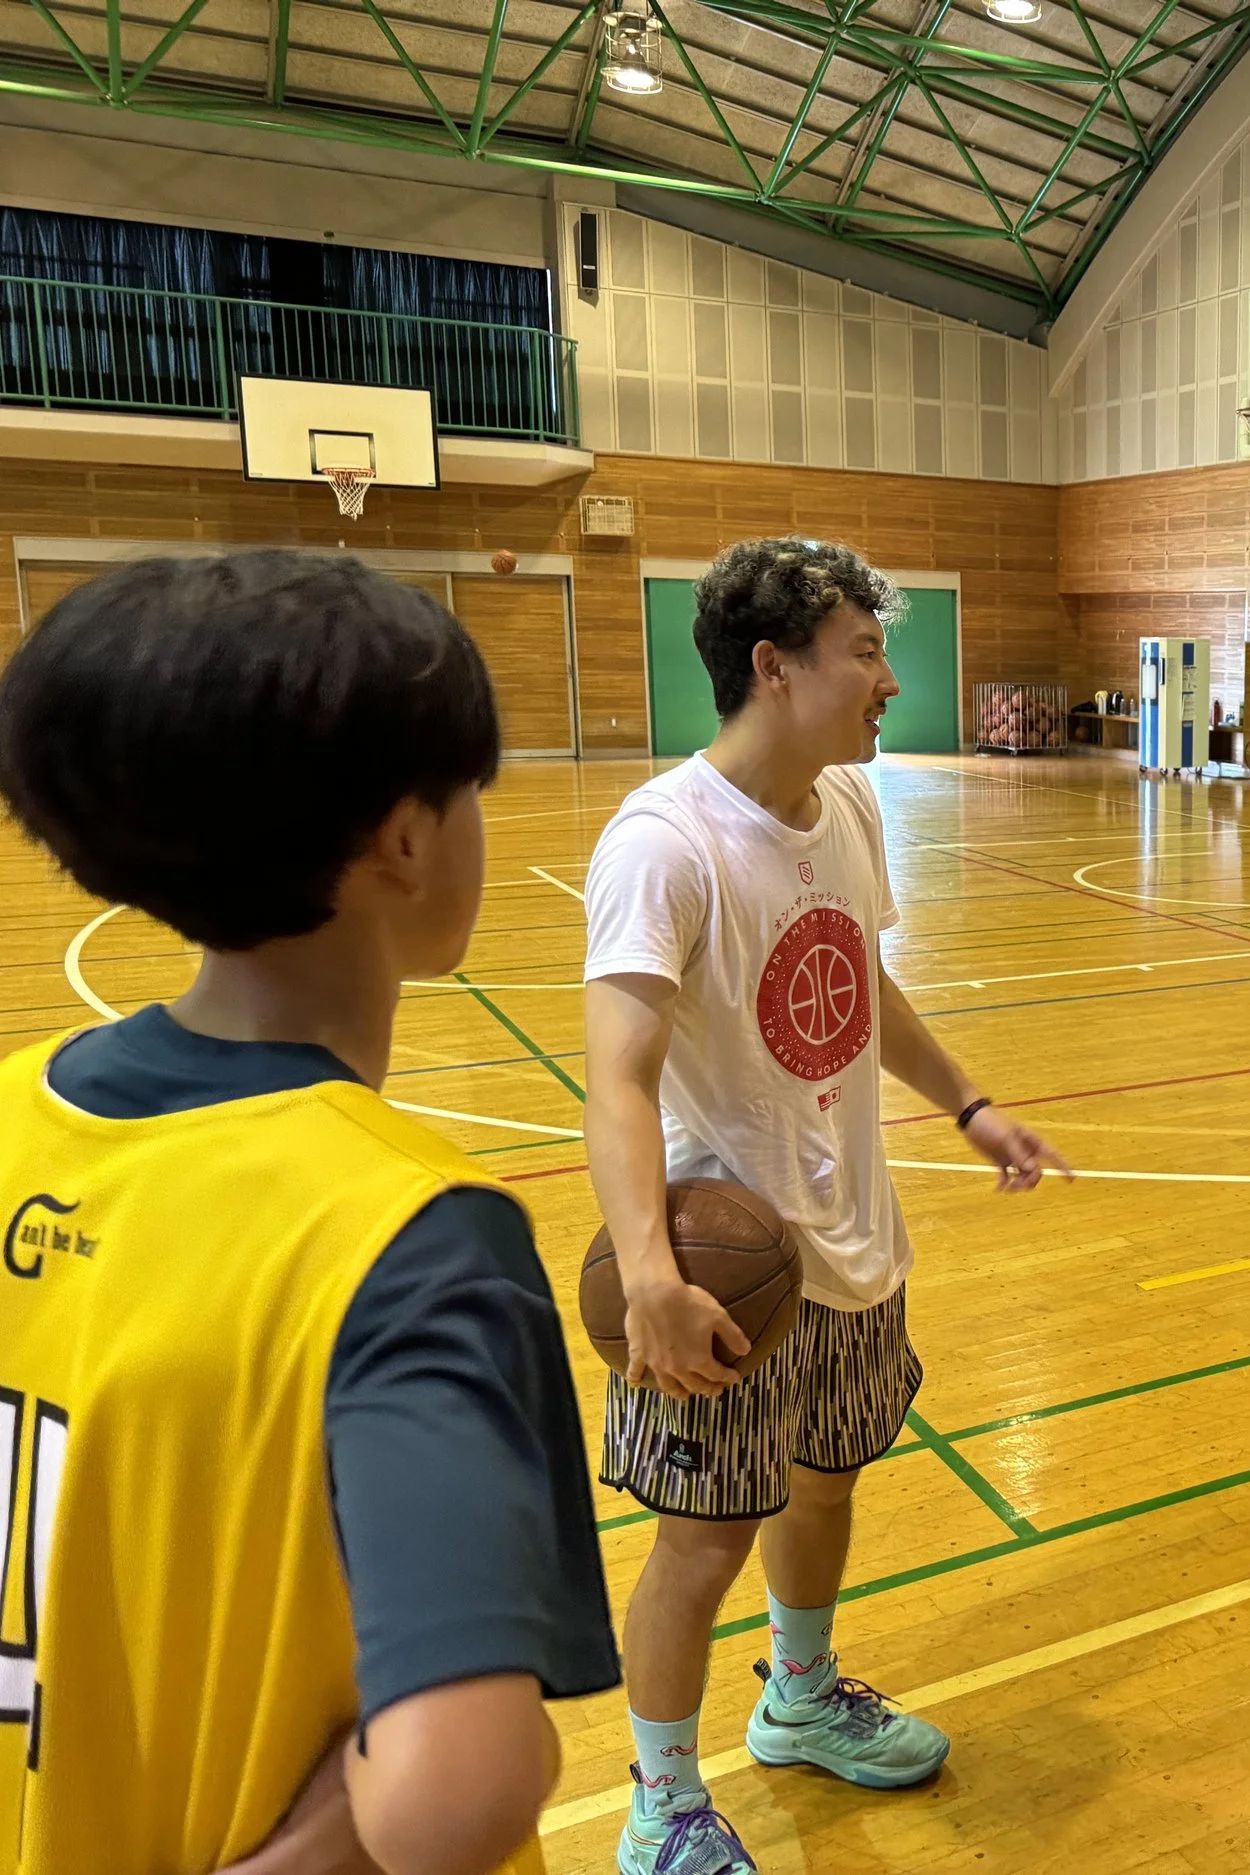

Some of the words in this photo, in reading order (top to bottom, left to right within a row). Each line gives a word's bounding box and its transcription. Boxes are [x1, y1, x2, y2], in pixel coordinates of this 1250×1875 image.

[766, 953, 782, 981] ON
[784, 919, 807, 946] THE
[763, 1017, 776, 1039] TO
[775, 1044, 813, 1077] BRING
[817, 1055, 847, 1077] HOPE
